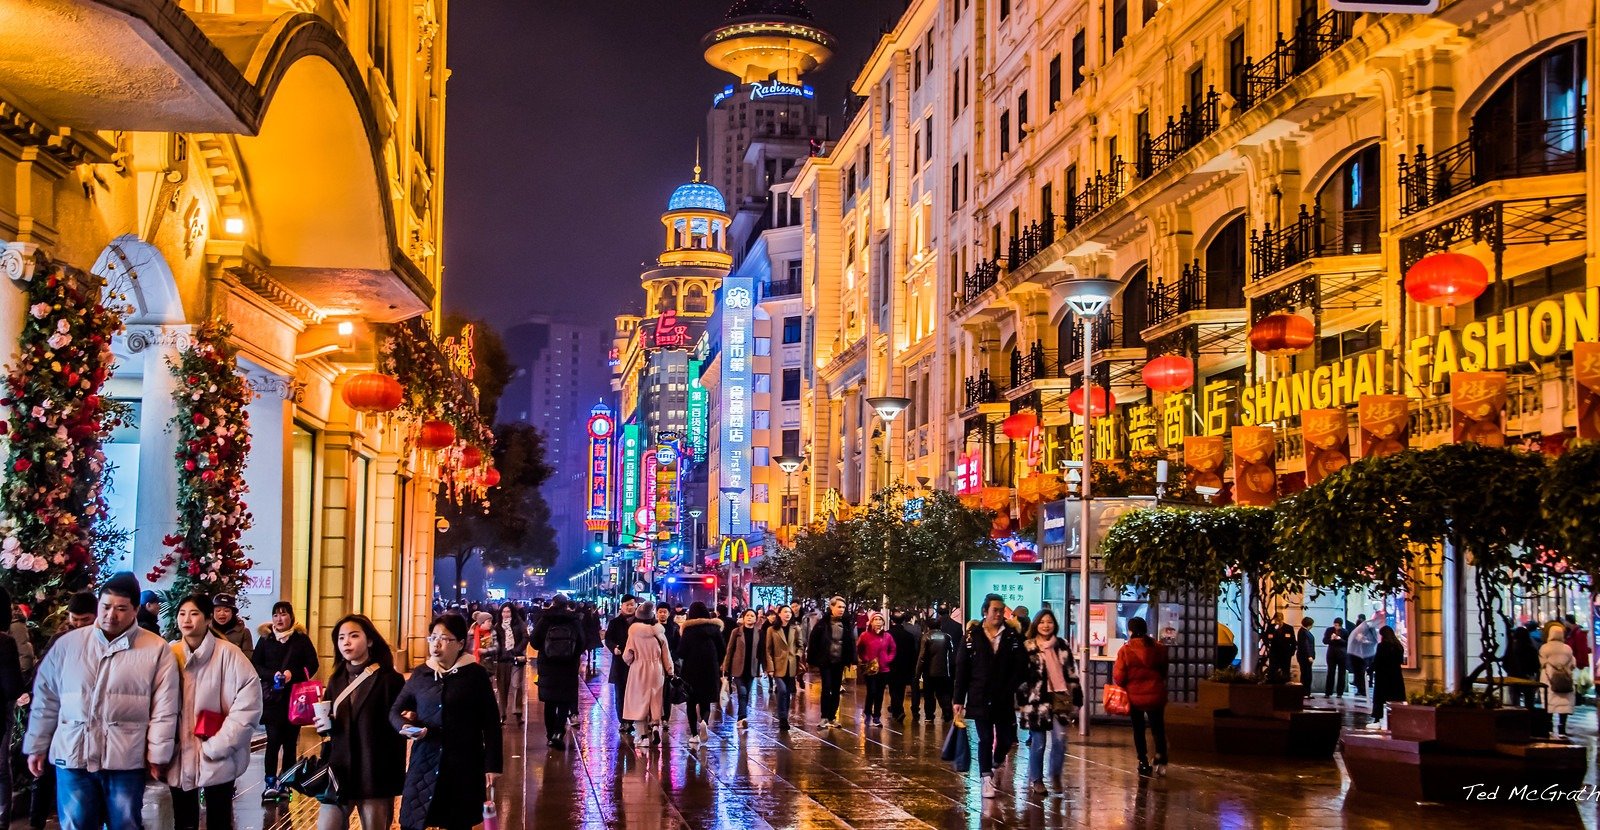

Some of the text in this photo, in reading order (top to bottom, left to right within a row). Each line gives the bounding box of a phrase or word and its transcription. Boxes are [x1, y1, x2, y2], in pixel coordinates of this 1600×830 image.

[750, 79, 802, 101] Radisson
[1241, 286, 1599, 427] SHANGHAI FASHION
[593, 443, 606, 507] 新世界城
[731, 450, 742, 525] First Fohall
[246, 575, 272, 589] 灭火点
[993, 584, 1023, 592] 智慧新春
